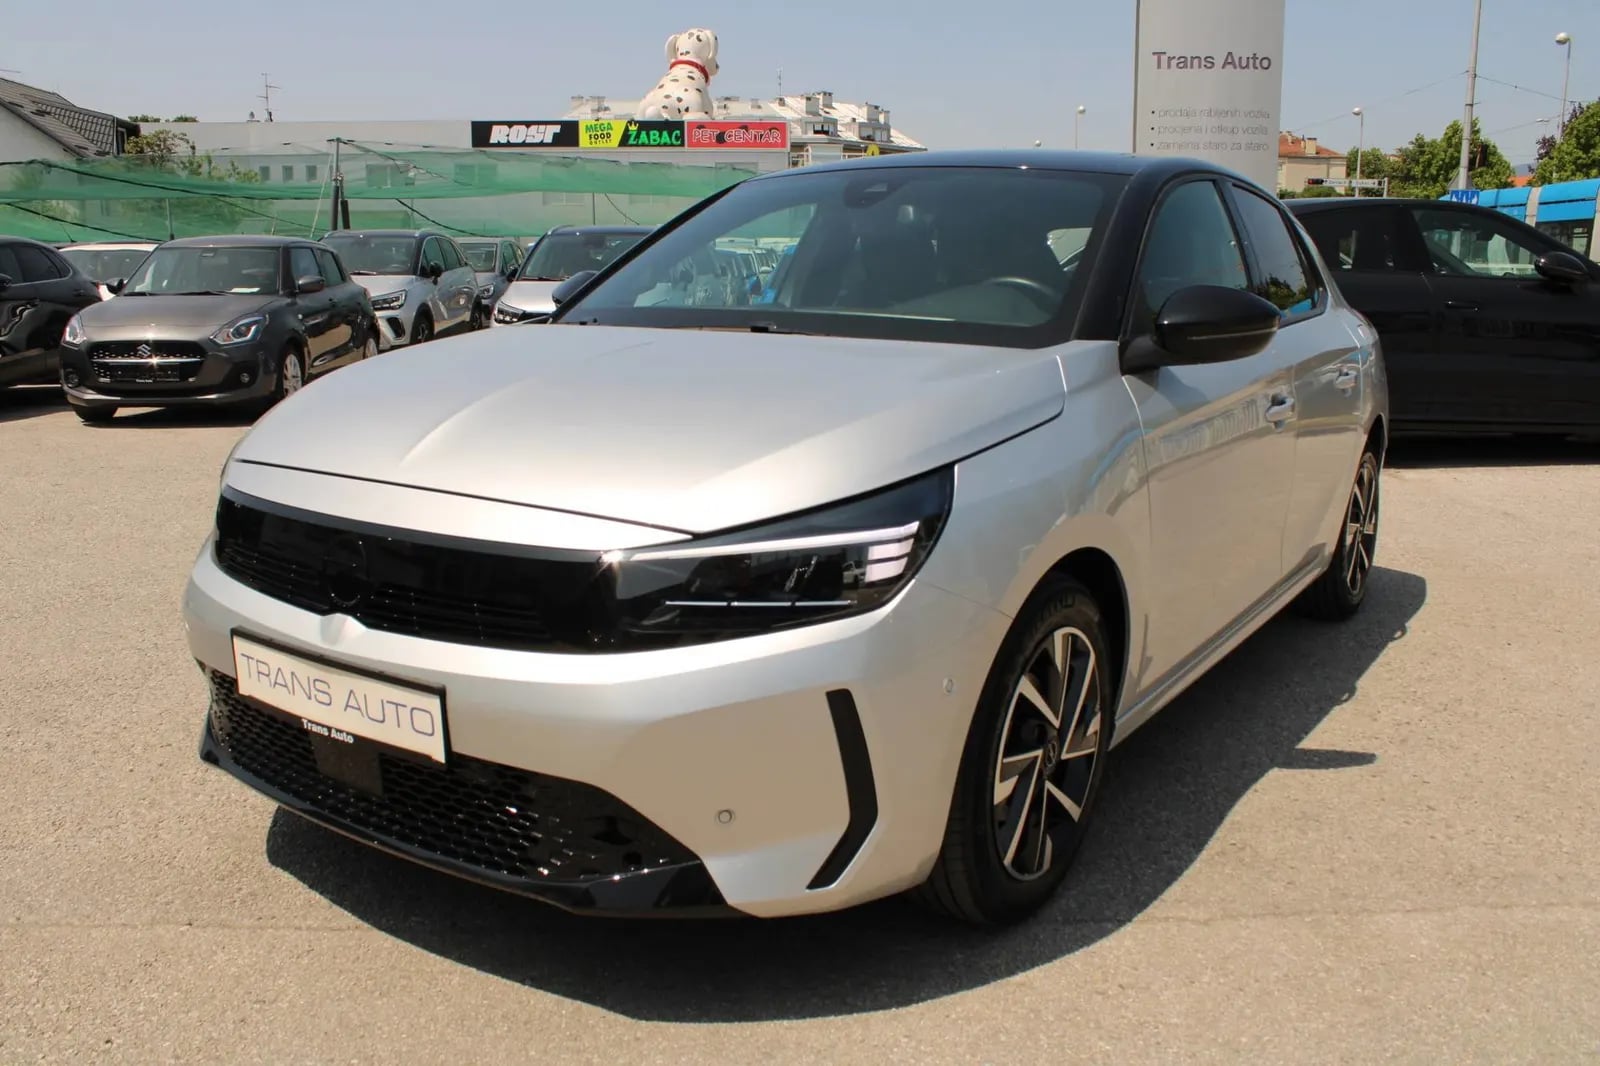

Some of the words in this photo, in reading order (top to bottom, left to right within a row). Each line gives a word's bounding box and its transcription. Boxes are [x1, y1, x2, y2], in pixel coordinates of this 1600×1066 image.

[1152, 51, 1215, 70] Trans
[1221, 51, 1272, 70] Auto
[489, 124, 561, 144] ROST
[585, 122, 613, 133] MEGA
[589, 132, 612, 141] FOOD
[693, 128, 719, 143] PET
[724, 128, 782, 143] CENTAR
[240, 652, 332, 707] TRANS
[344, 689, 435, 737] AUTO
[301, 718, 329, 736] Trans
[330, 727, 354, 744] Auto
